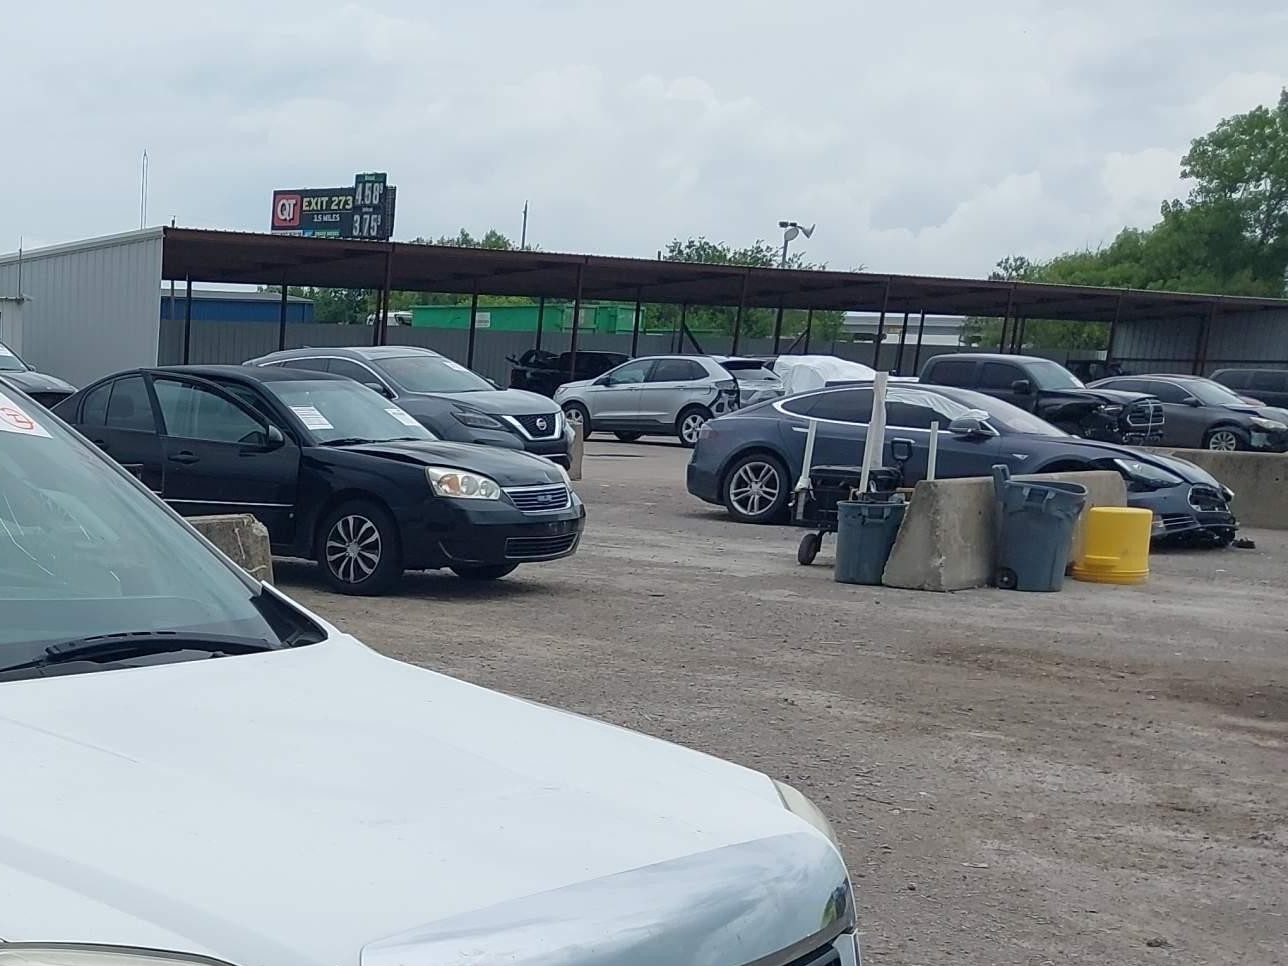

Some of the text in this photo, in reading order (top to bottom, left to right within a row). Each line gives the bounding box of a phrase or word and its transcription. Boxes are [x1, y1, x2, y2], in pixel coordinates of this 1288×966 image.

[277, 199, 296, 221] QT
[303, 196, 353, 211] EXIT 273
